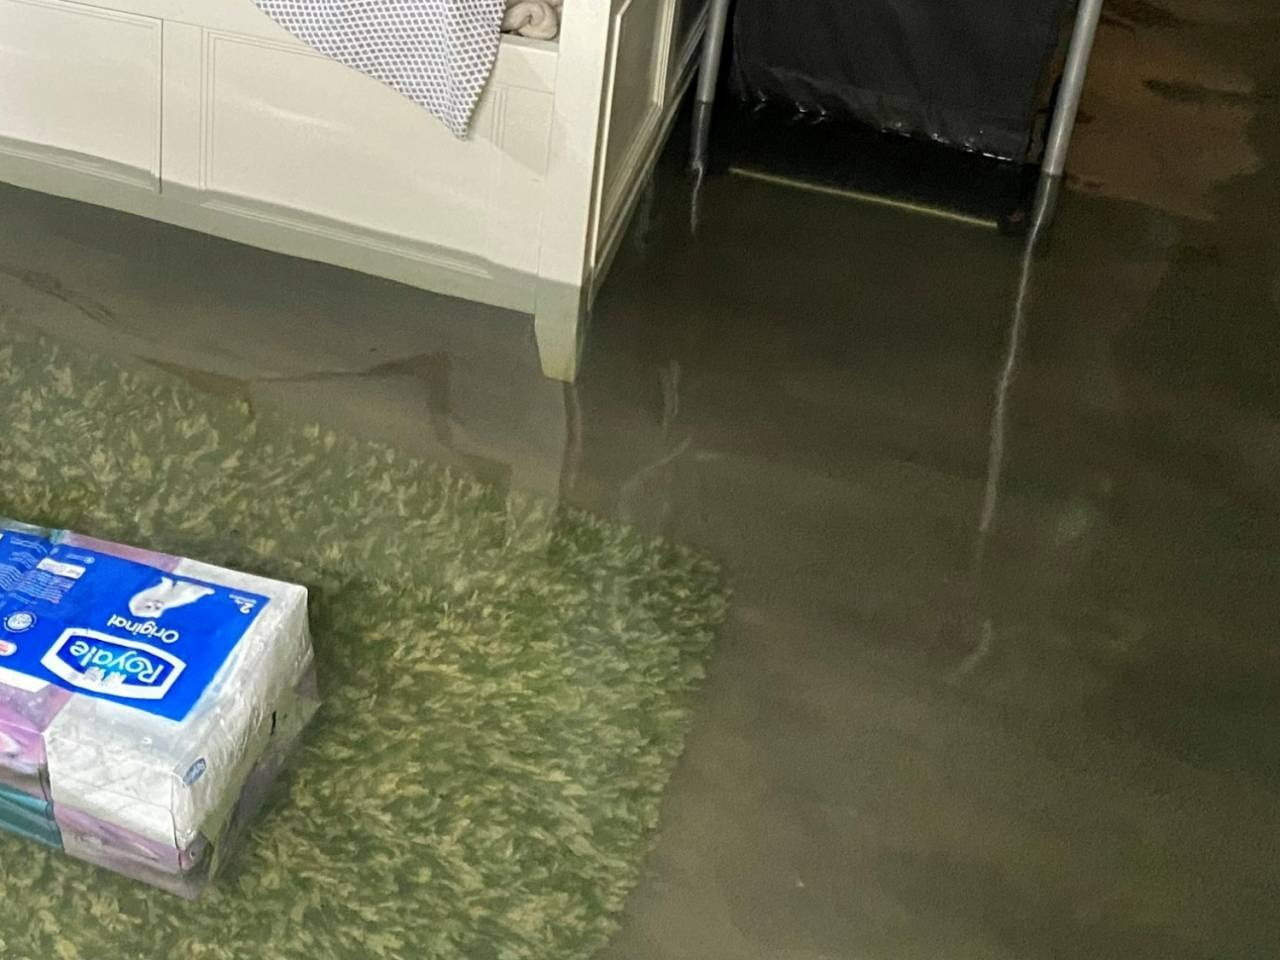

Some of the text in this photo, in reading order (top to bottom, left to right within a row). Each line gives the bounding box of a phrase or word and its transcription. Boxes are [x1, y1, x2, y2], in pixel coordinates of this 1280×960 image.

[239, 601, 255, 614] 2
[107, 614, 180, 644] Original
[69, 640, 165, 684] Royale
